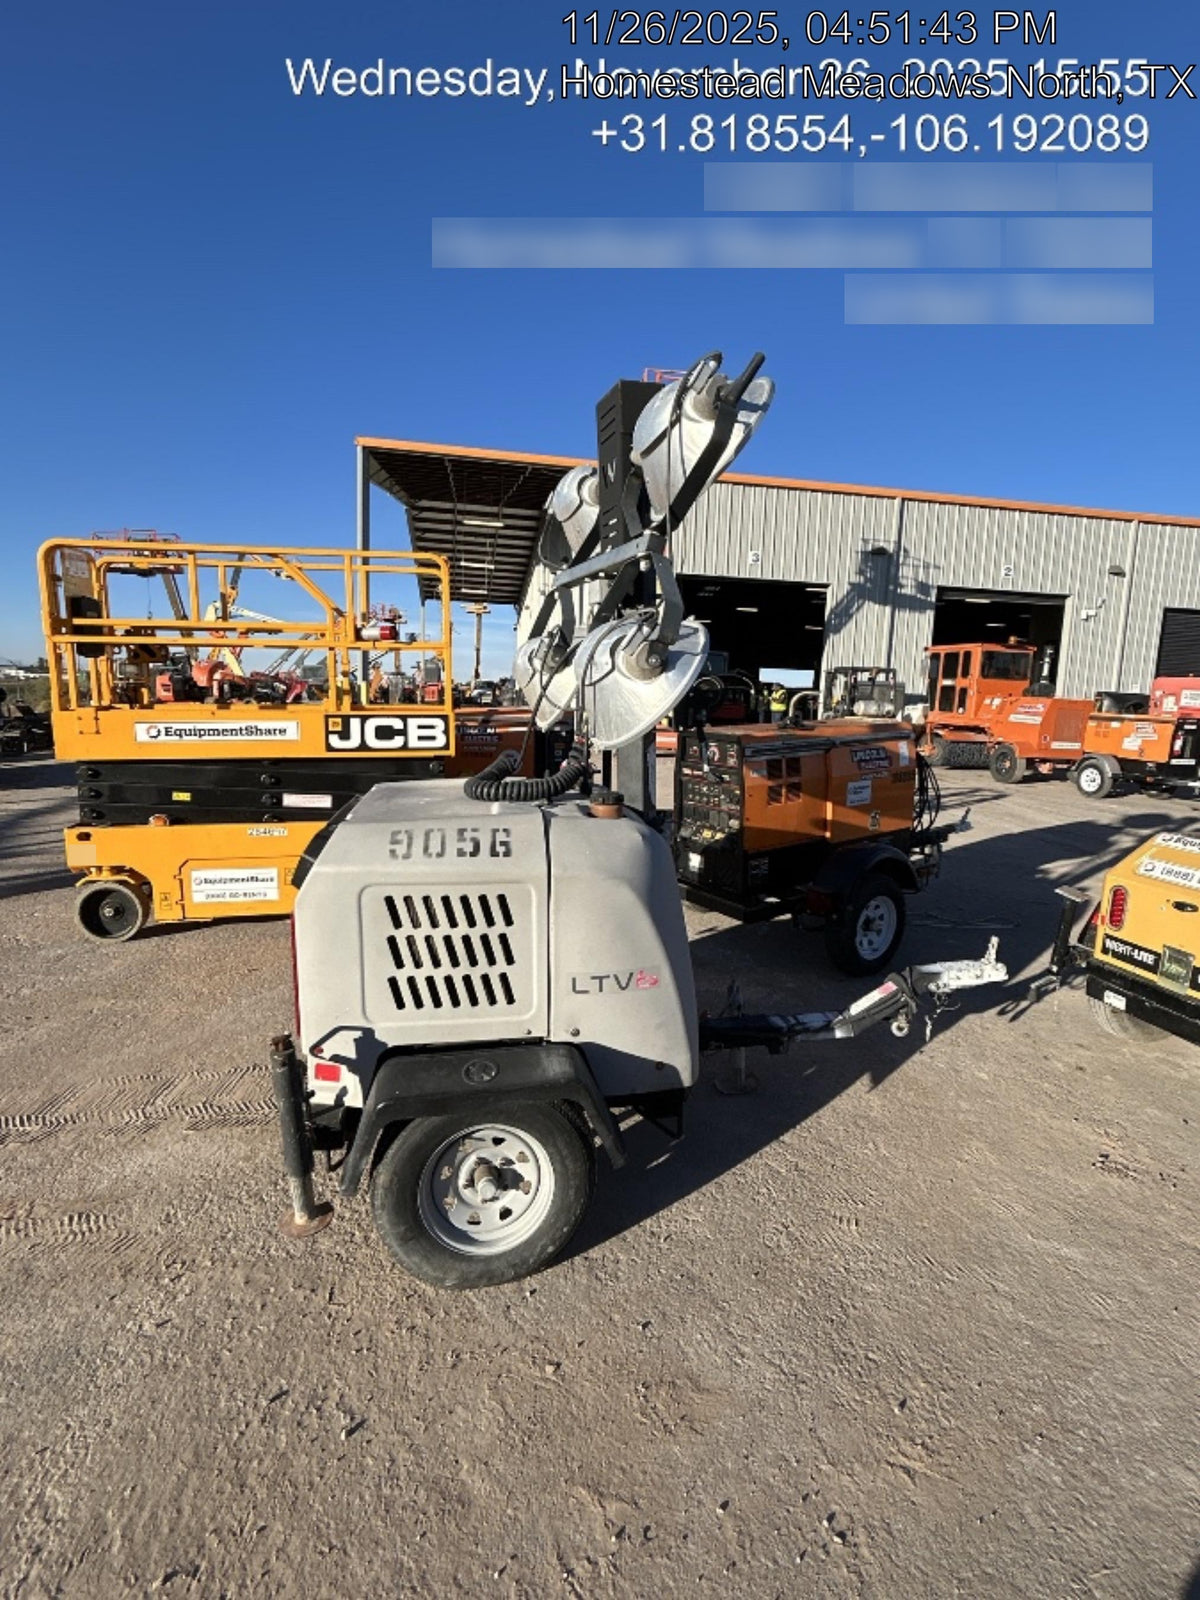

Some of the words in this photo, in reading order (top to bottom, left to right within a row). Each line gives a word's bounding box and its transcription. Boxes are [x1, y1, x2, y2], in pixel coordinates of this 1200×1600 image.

[751, 552, 760, 563] 3
[1003, 566, 1012, 577] 2
[164, 725, 287, 738] EquipmentShare
[328, 717, 447, 750] JCB
[1105, 937, 1157, 966] NIGHT-LITE
